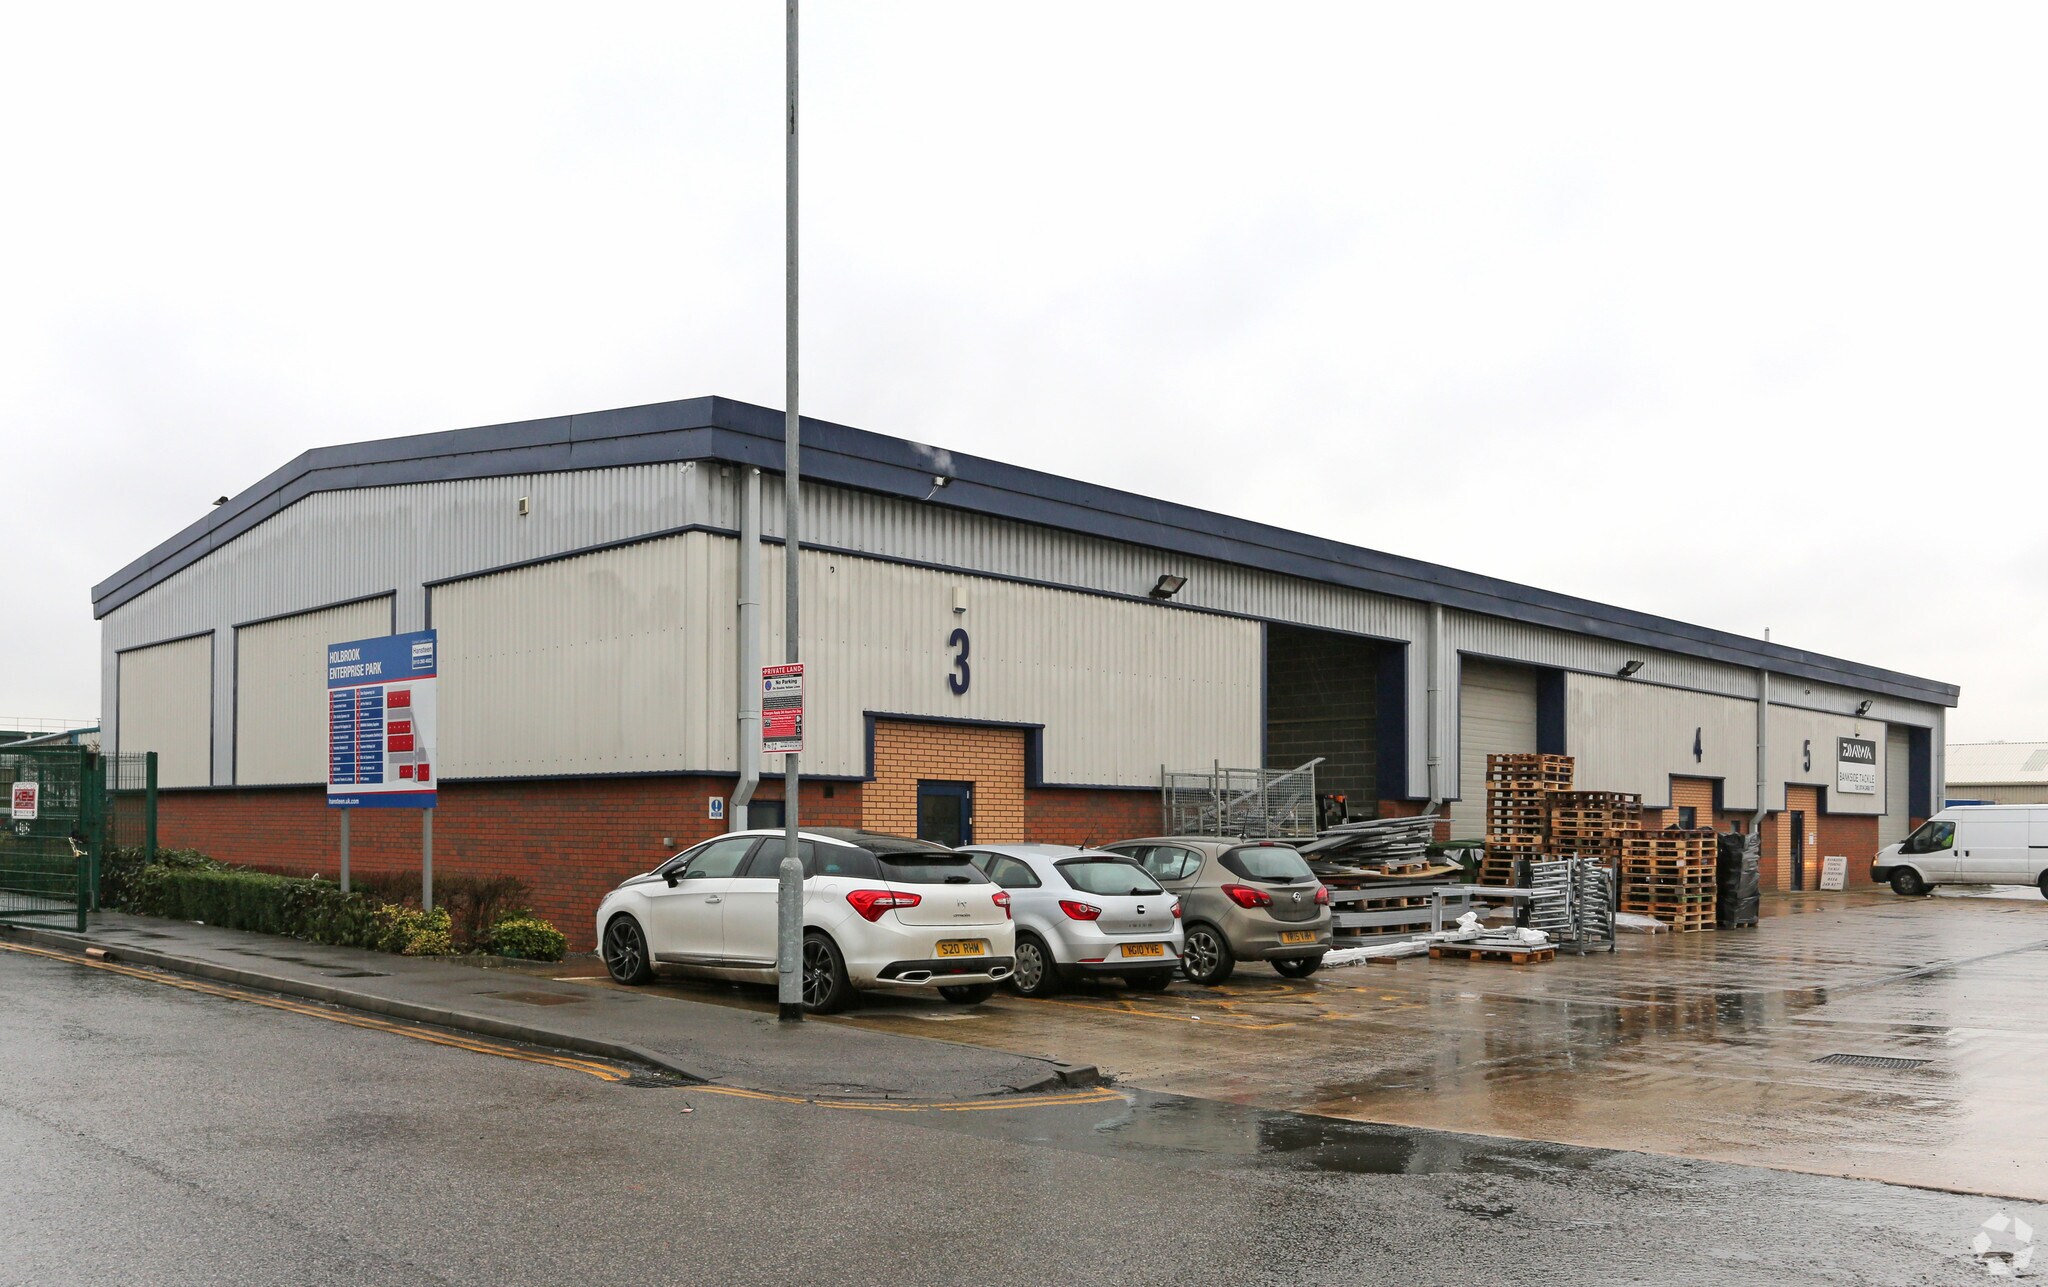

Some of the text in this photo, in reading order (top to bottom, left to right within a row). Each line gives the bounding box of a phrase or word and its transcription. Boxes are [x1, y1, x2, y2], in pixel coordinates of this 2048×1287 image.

[329, 648, 361, 664] HOLBROOK
[948, 627, 971, 696] 3
[329, 662, 382, 680] ENTERPRISE PARK
[764, 665, 802, 675] PRIVATE LAND
[1693, 726, 1703, 764] 4
[1842, 742, 1873, 760] DAIWA
[1803, 739, 1811, 773] 5
[1839, 772, 1875, 784] BANKSIDE TACKLE
[941, 943, 960, 955] S20
